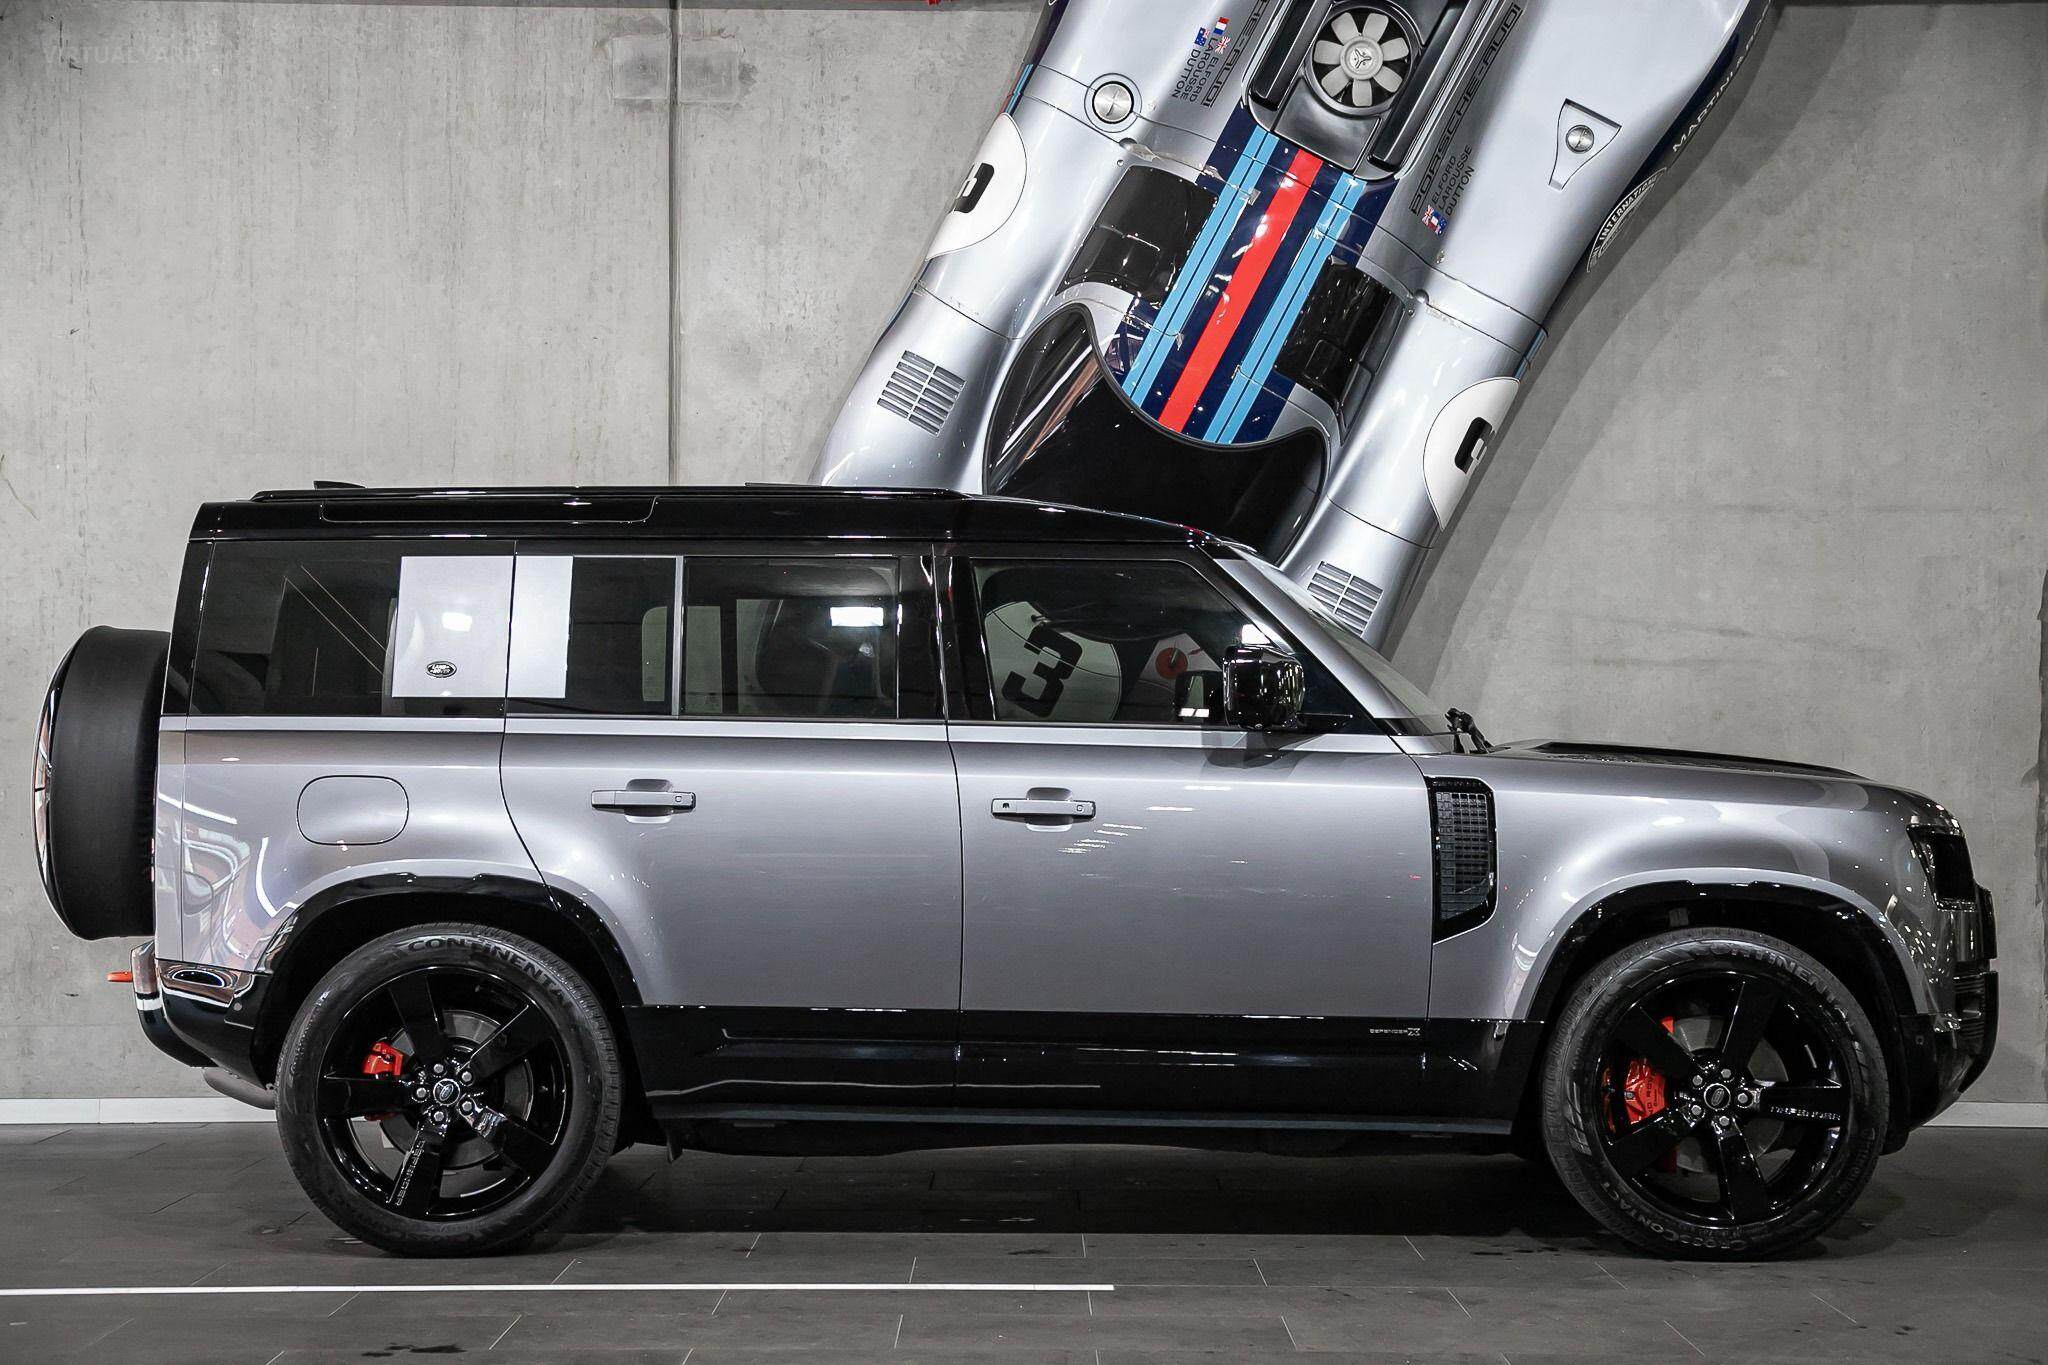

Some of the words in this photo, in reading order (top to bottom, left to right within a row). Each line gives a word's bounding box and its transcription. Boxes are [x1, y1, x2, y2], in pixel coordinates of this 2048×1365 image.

[1171, 49, 1201, 99] DUTTON
[1180, 37, 1219, 100] LAROUSSE
[1189, 56, 1219, 102] ELFORD
[1203, 0, 1267, 108] HE-AUDI
[1410, 4, 1522, 214] PORSCHE-AUDI
[1431, 155, 1457, 205] ELFORD
[1438, 144, 1473, 211] LAROUSSE
[1446, 165, 1475, 217] DUTTON
[1001, 625, 1083, 718] 3
